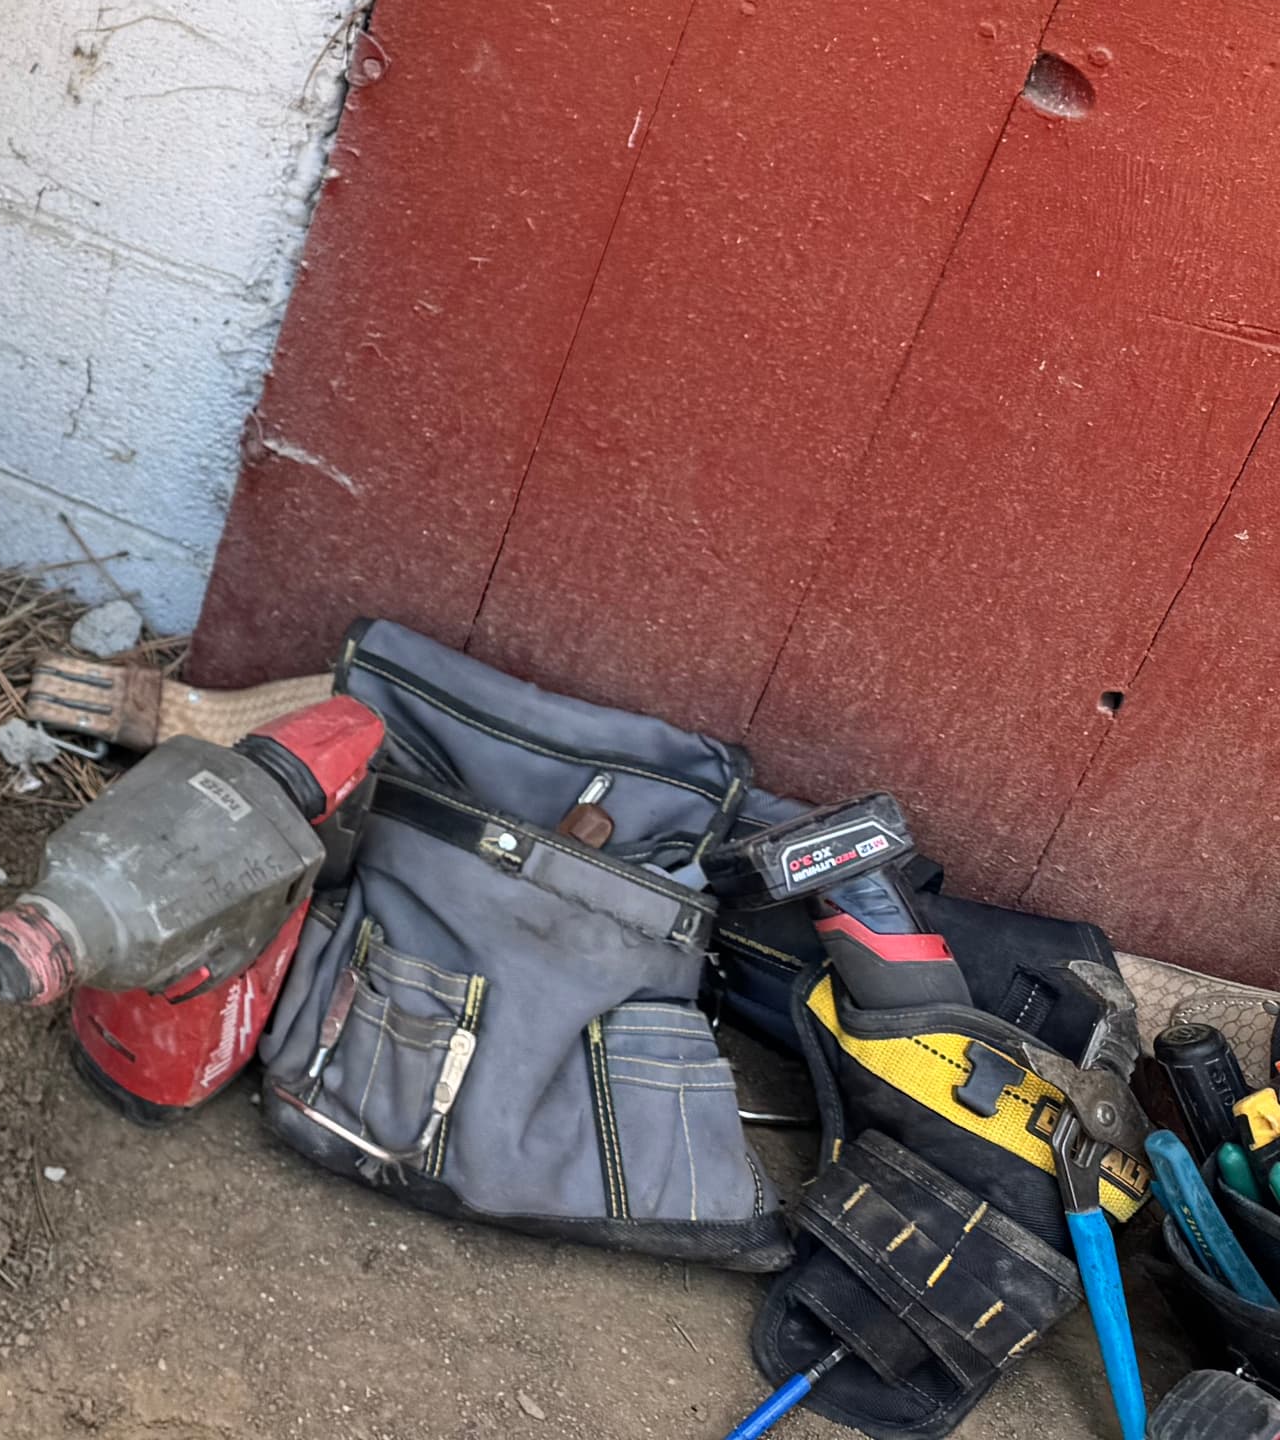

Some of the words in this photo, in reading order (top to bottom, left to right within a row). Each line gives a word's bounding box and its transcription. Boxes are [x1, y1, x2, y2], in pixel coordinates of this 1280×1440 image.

[860, 838, 885, 854] M12
[791, 849, 858, 882] REDLITHIUM
[200, 982, 241, 1088] Milwaukee
